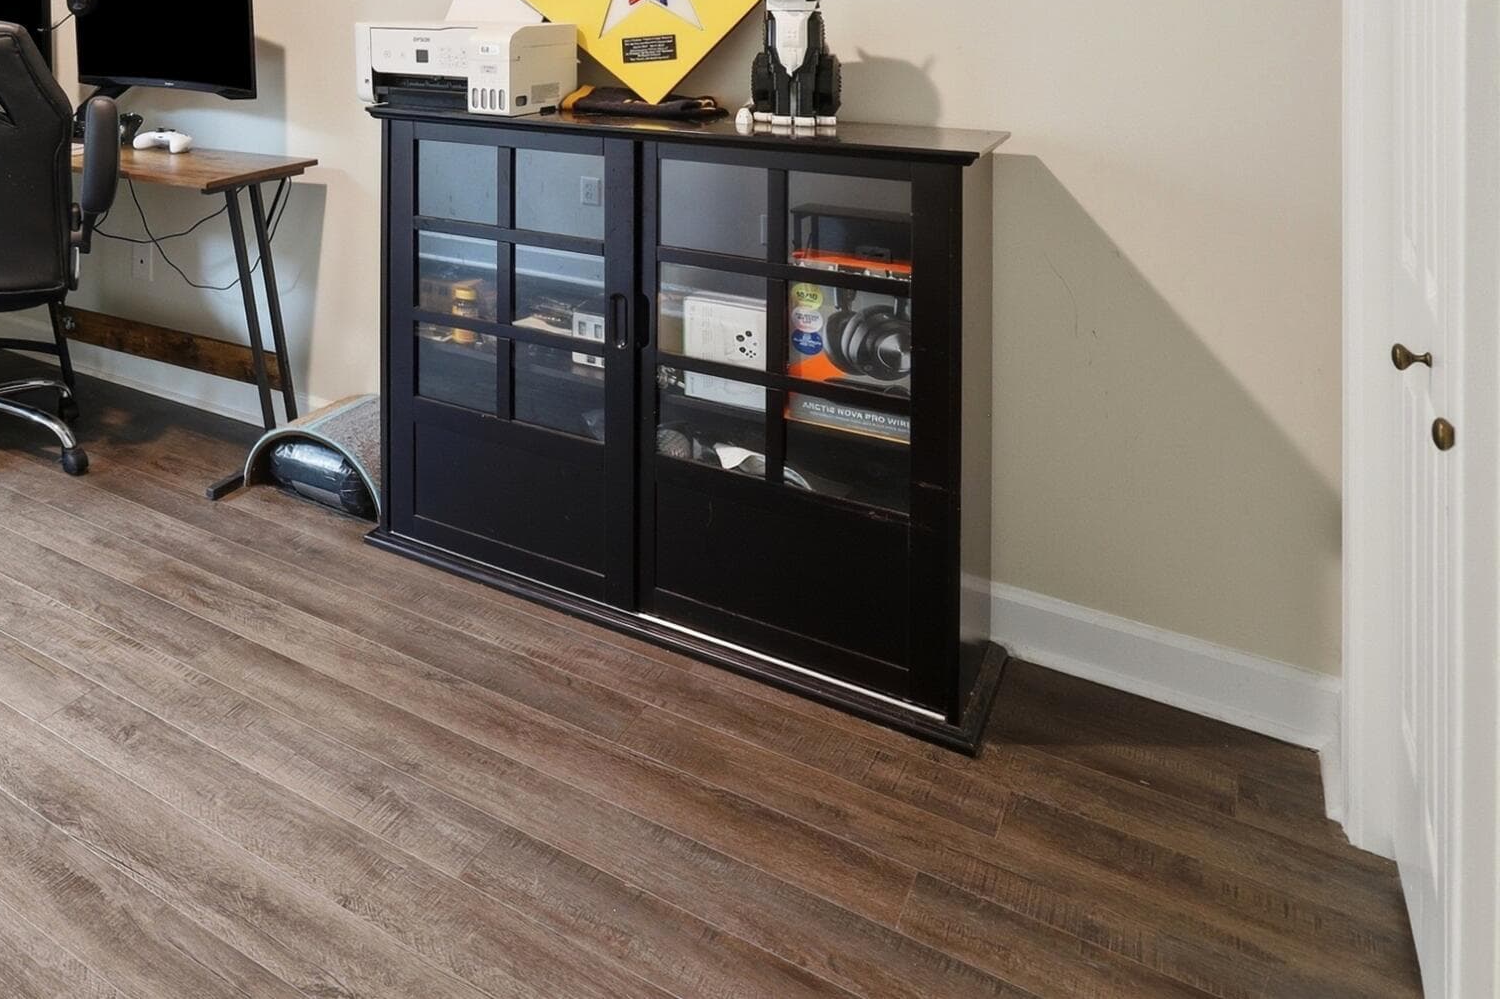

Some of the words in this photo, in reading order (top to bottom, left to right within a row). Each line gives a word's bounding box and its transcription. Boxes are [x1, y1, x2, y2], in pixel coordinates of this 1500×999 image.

[802, 401, 835, 413] ARCTIS
[837, 408, 863, 419] NOVA
[865, 414, 885, 423] PRO
